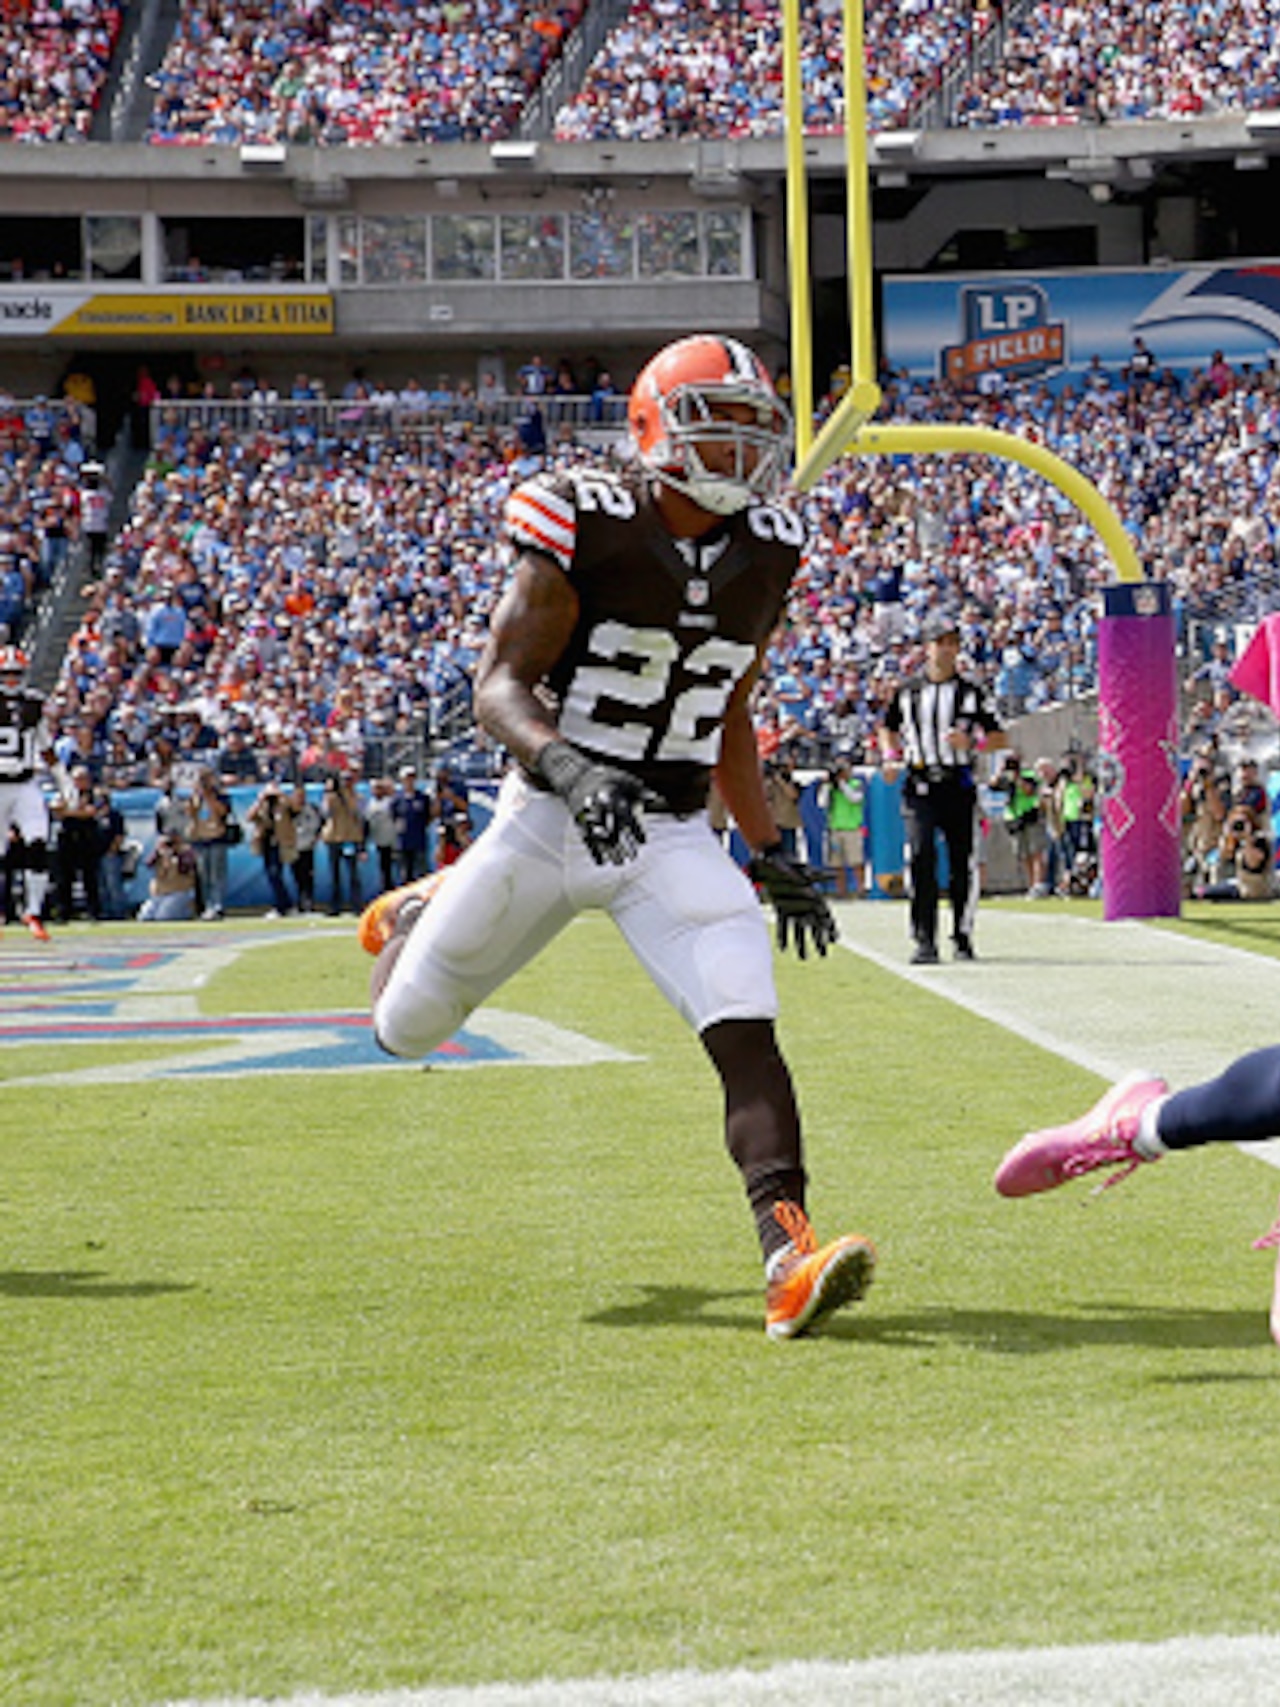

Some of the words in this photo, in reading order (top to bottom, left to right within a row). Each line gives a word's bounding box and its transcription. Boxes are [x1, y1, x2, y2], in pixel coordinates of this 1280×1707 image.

[185, 303, 228, 324] BANK
[233, 303, 264, 324] LIKE
[271, 303, 286, 324] A
[286, 303, 331, 324] TITAN
[976, 296, 1037, 330] LP
[973, 334, 1045, 365] FIELD
[559, 619, 757, 765] 22
